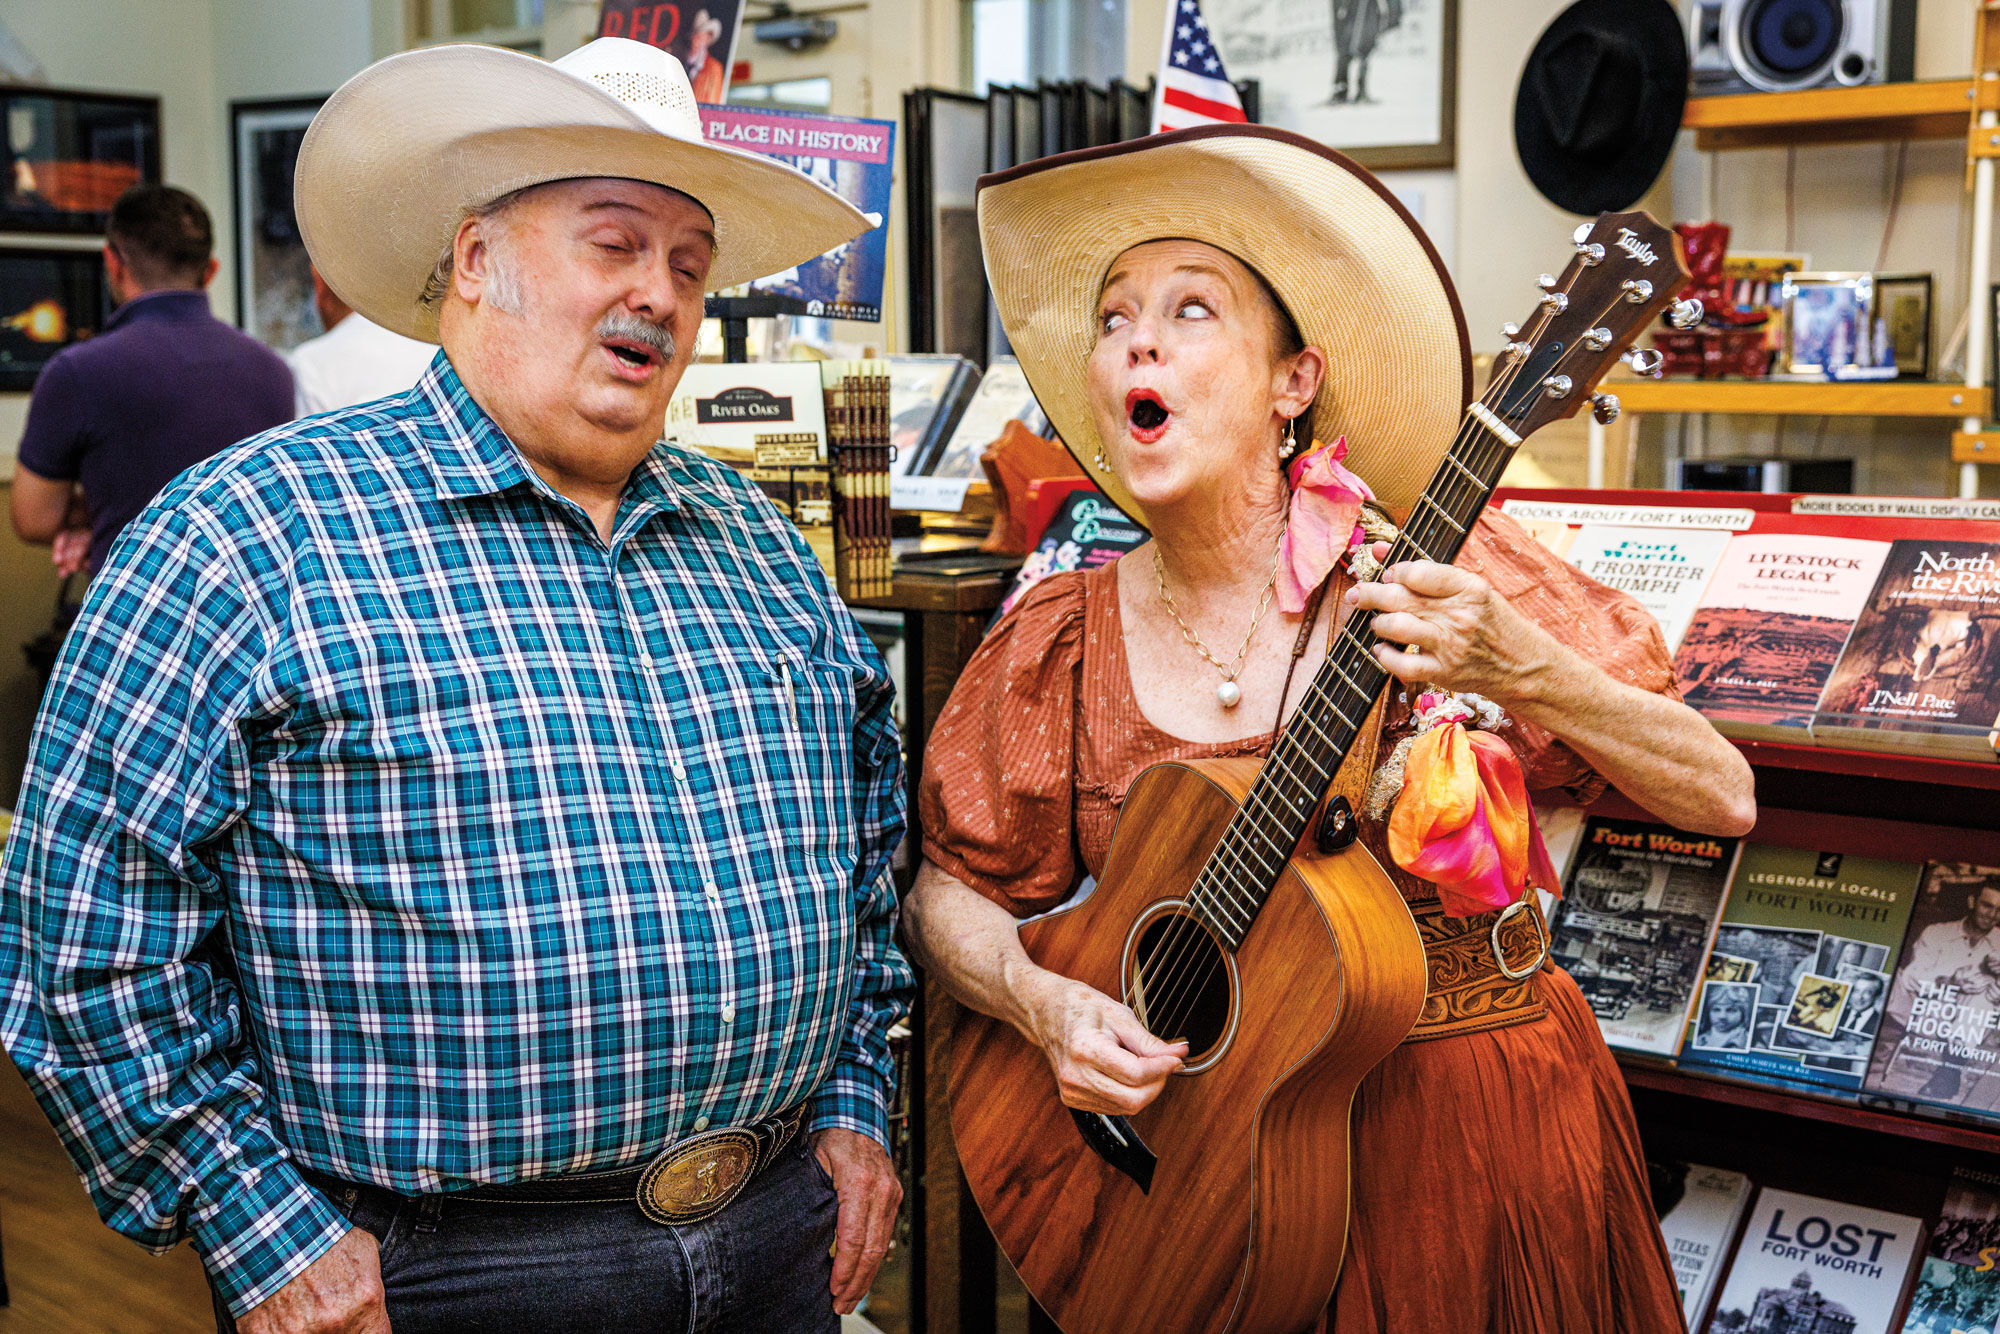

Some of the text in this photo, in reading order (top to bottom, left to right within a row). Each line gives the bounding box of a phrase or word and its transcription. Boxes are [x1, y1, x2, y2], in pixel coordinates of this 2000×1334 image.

[708, 121, 770, 144] PLACE
[772, 127, 796, 146] IN
[798, 131, 882, 154] HISTORY
[1613, 228, 1659, 266] Taylor
[711, 402, 780, 417] RIVER OAKS
[1508, 505, 1748, 526] BOOKS ABOUT FORT WORTH
[1799, 502, 1832, 512] MORE
[1836, 502, 1874, 513] BOOKS
[1878, 504, 1891, 513] BY
[1896, 504, 1927, 515] WALL
[1931, 505, 1977, 516] DISPLAY
[1603, 550, 1687, 562] Worth
[1620, 541, 1678, 552] Fort
[1591, 560, 1705, 580] FRONTIER
[1748, 553, 1862, 570] LIVESTOCK
[1913, 550, 1995, 574] North
[1595, 575, 1681, 594] RIUMPH
[1757, 568, 1837, 583] LEGACY
[1912, 569, 1953, 590] the
[1868, 690, 1956, 710] J'Nell Pate
[1592, 827, 1723, 859] Fort Worth
[1748, 873, 1898, 903] LEGENDARY LOCALS
[1745, 889, 1890, 923] FORT WORTH
[1918, 980, 1961, 1004] THE
[1910, 997, 2000, 1031] BROTHE
[1906, 1014, 1986, 1047] HOGAN
[1900, 1035, 1997, 1064] A FORT WORTH
[1766, 1208, 1897, 1263] LOST
[1673, 1237, 1711, 1257] TEXAS
[1761, 1240, 1883, 1279] FORT WORTH
